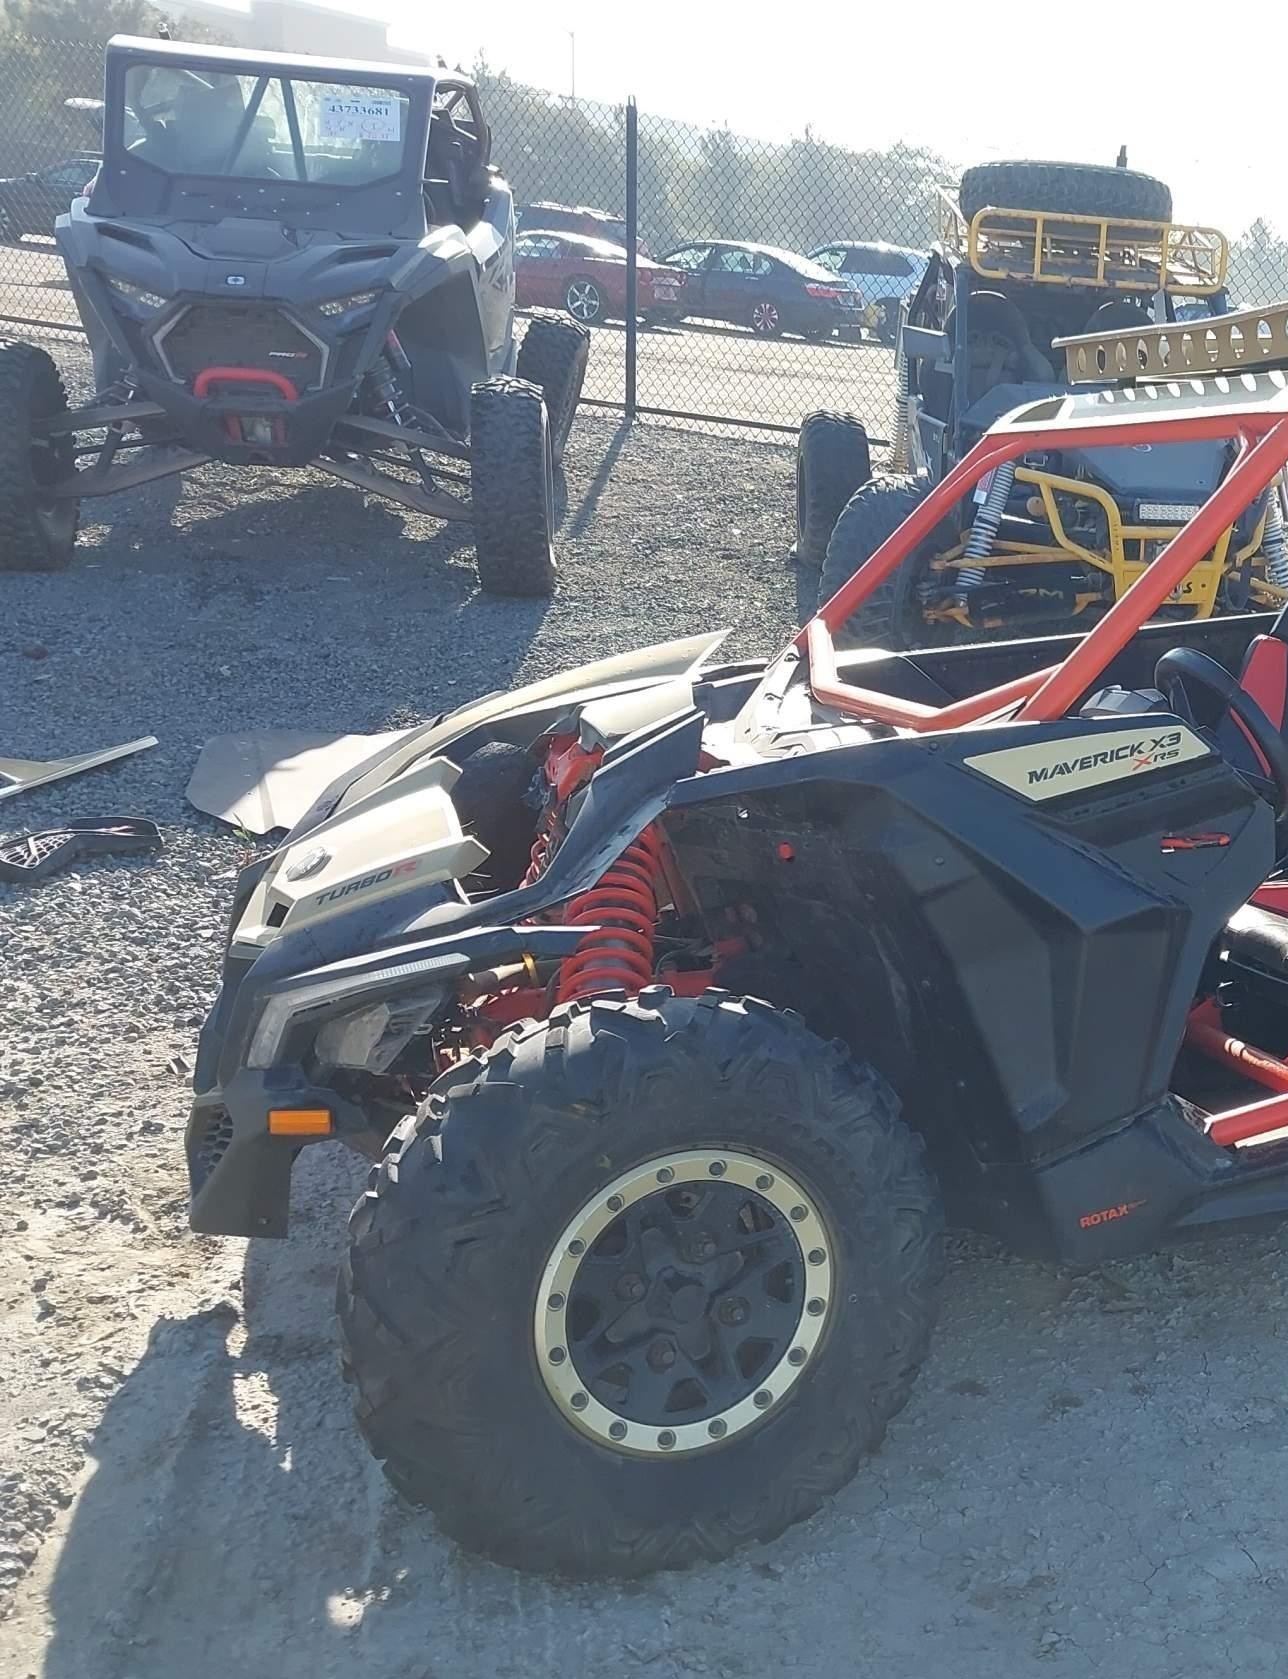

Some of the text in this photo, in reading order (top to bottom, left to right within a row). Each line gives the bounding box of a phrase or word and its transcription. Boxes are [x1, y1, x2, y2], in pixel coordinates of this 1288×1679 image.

[328, 104, 389, 116] 43733681
[1028, 731, 1182, 784] MAVERICK X3
[1131, 748, 1181, 772] XRS
[1080, 1204, 1129, 1229] ROTAX
